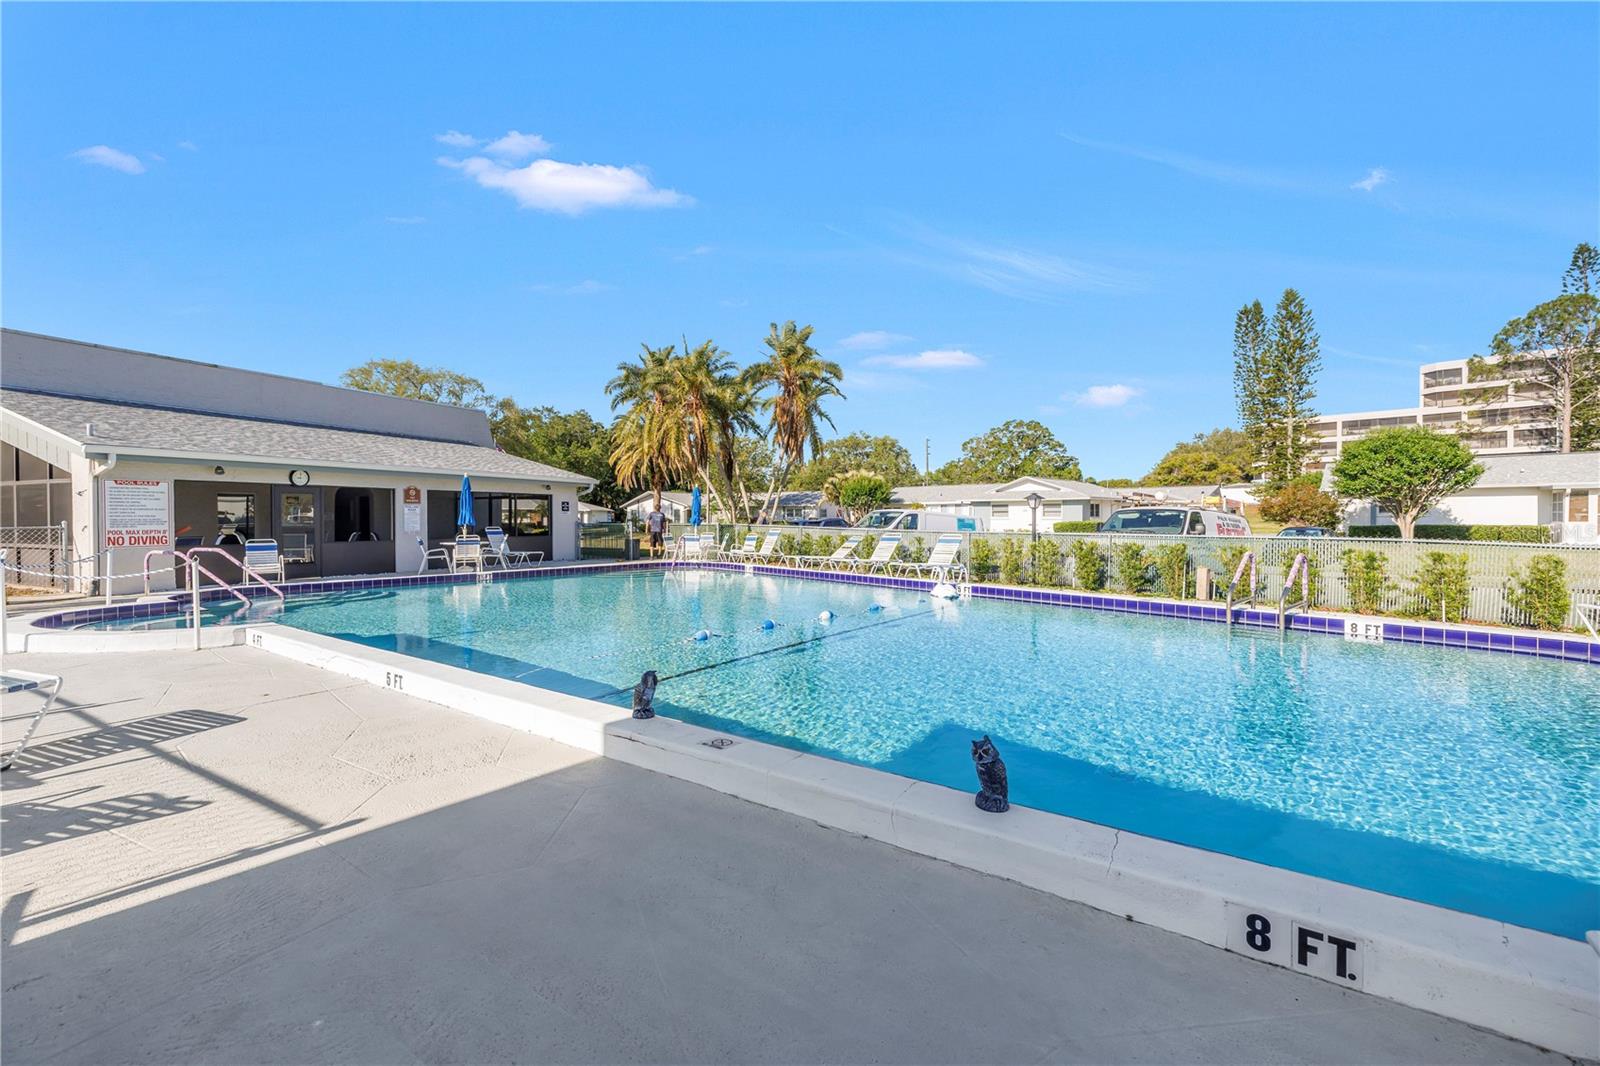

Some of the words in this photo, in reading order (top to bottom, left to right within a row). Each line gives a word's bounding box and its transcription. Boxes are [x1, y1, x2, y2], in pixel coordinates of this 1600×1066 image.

[107, 535, 125, 546] NO
[128, 535, 168, 546] DIVING
[1350, 622, 1358, 633] 8
[386, 671, 391, 686] 5
[1246, 913, 1272, 952] 8
[1298, 926, 1357, 981] FT.
